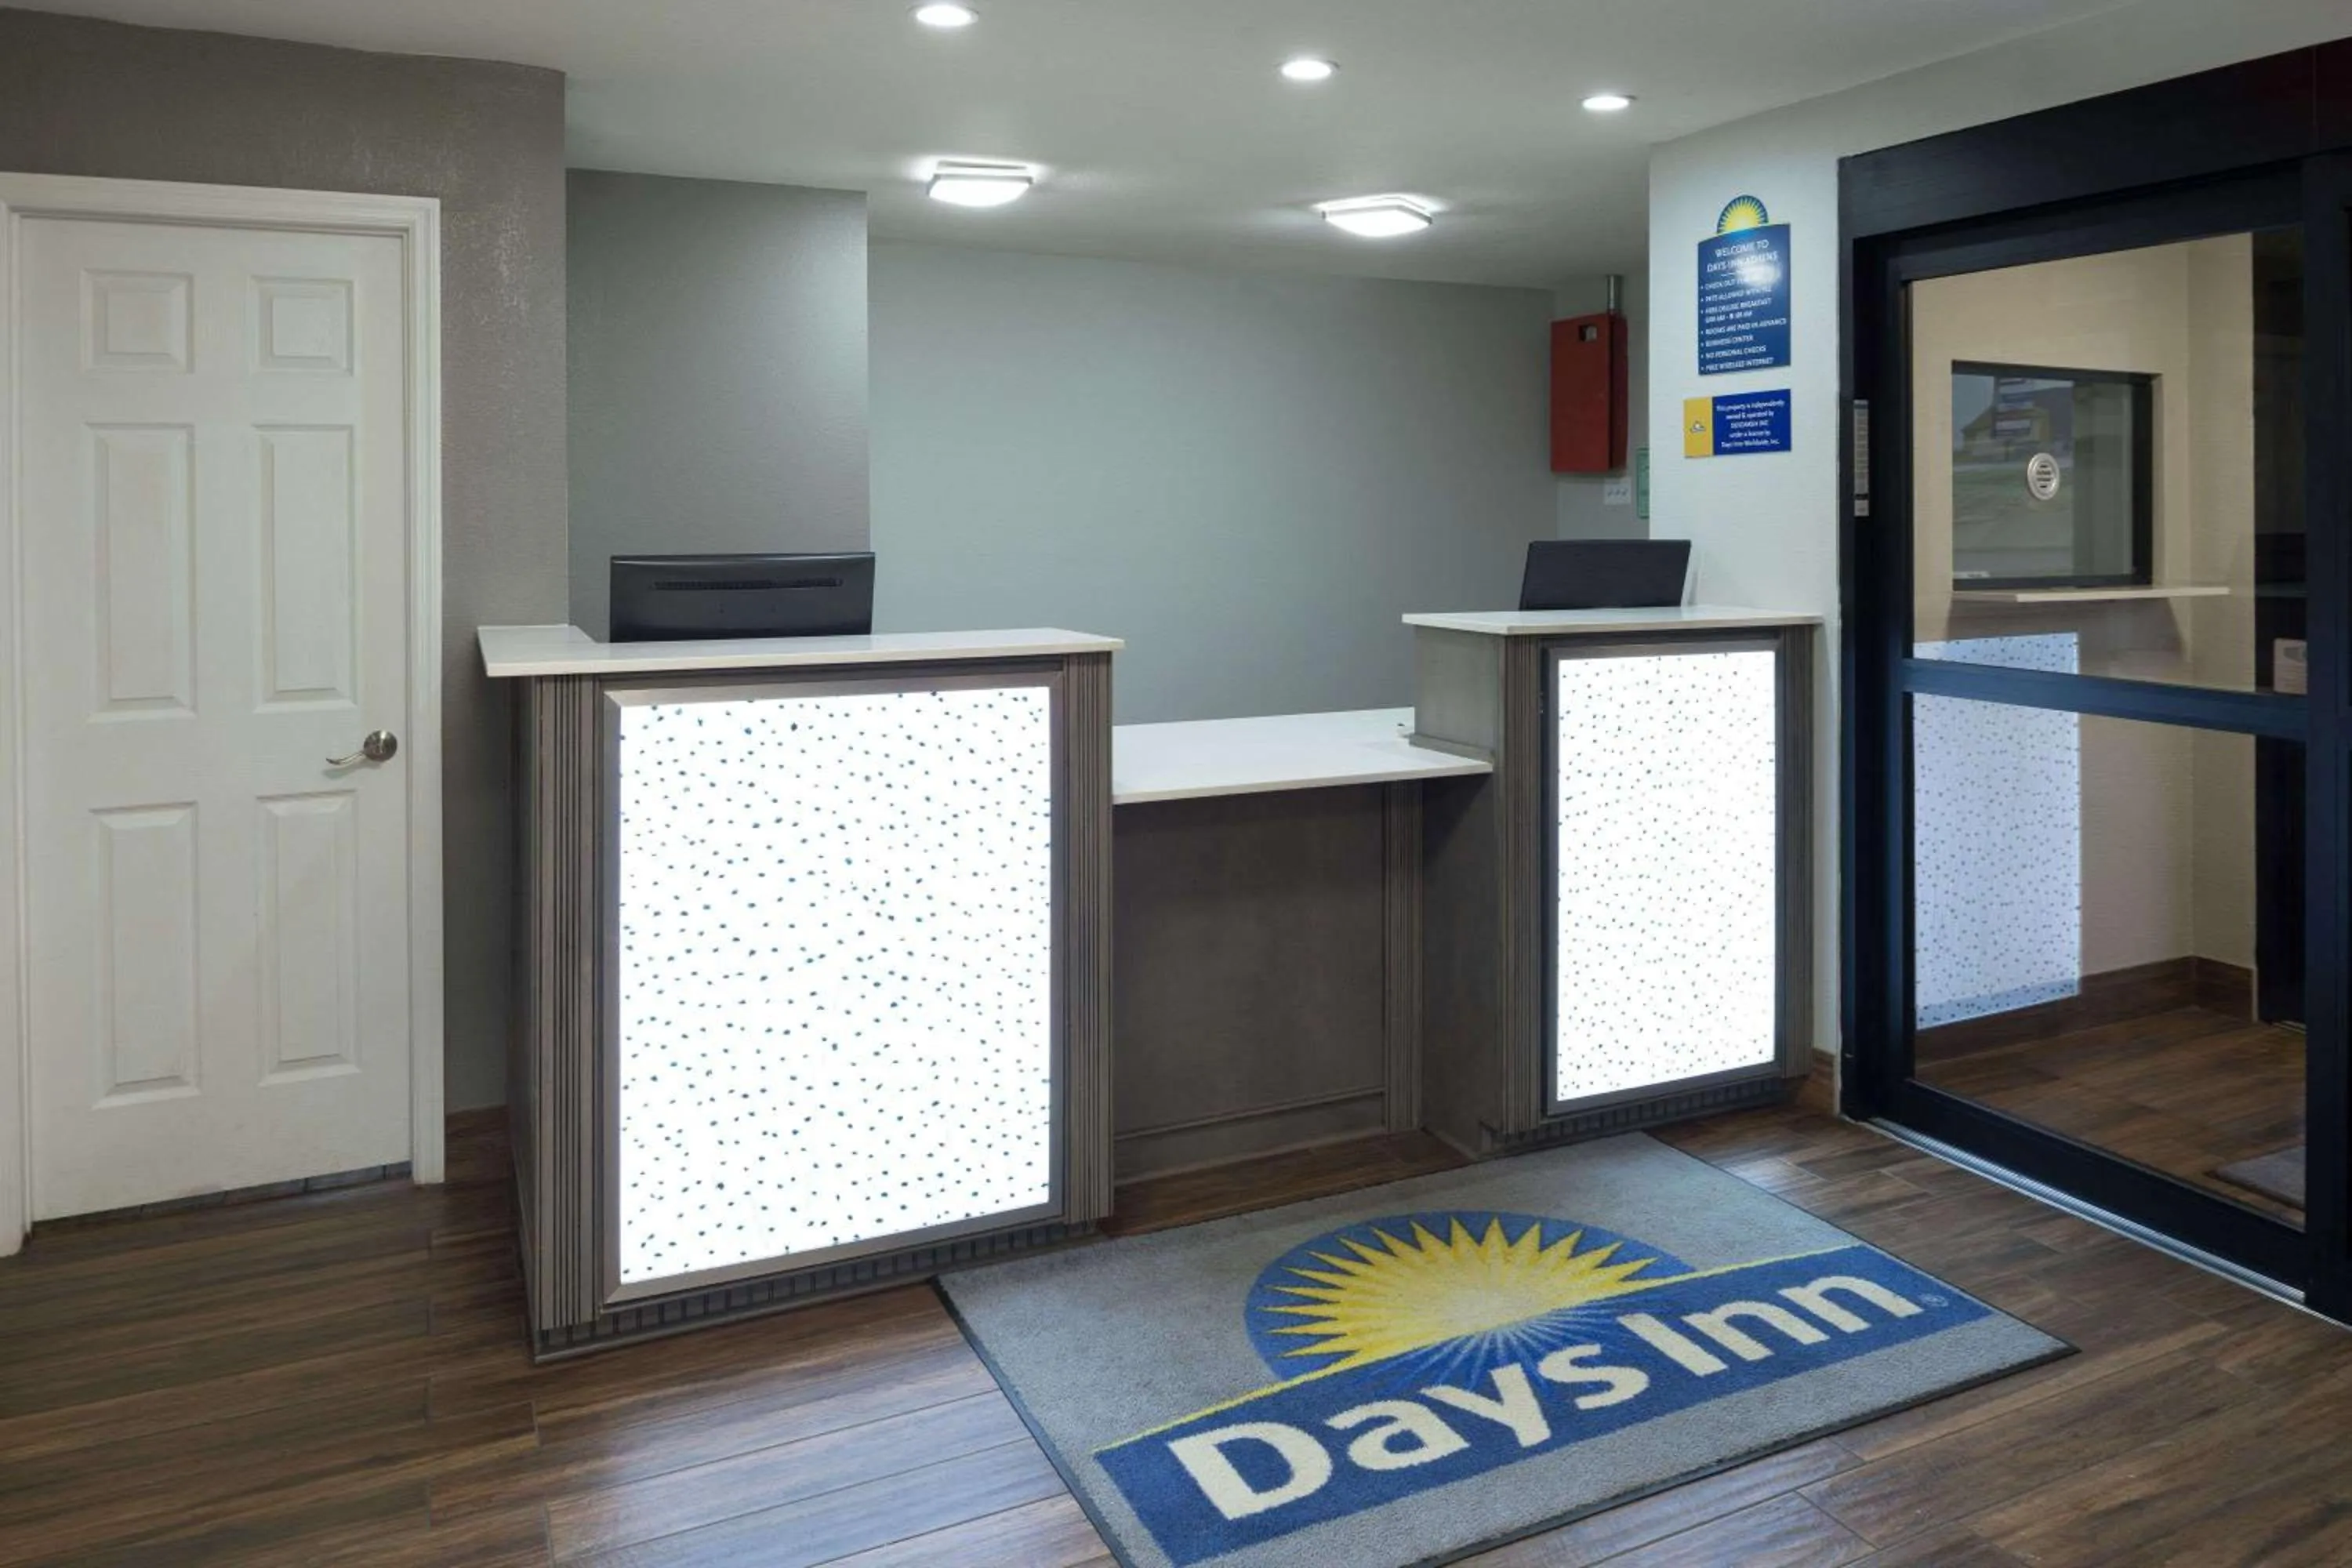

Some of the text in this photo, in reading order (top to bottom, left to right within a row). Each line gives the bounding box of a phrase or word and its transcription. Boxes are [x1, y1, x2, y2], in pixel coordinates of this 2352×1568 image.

[1715, 239, 1769, 257] WELCOME TO
[1707, 260, 1726, 272] DAYS
[1169, 1274, 1925, 1521] Days Inn
